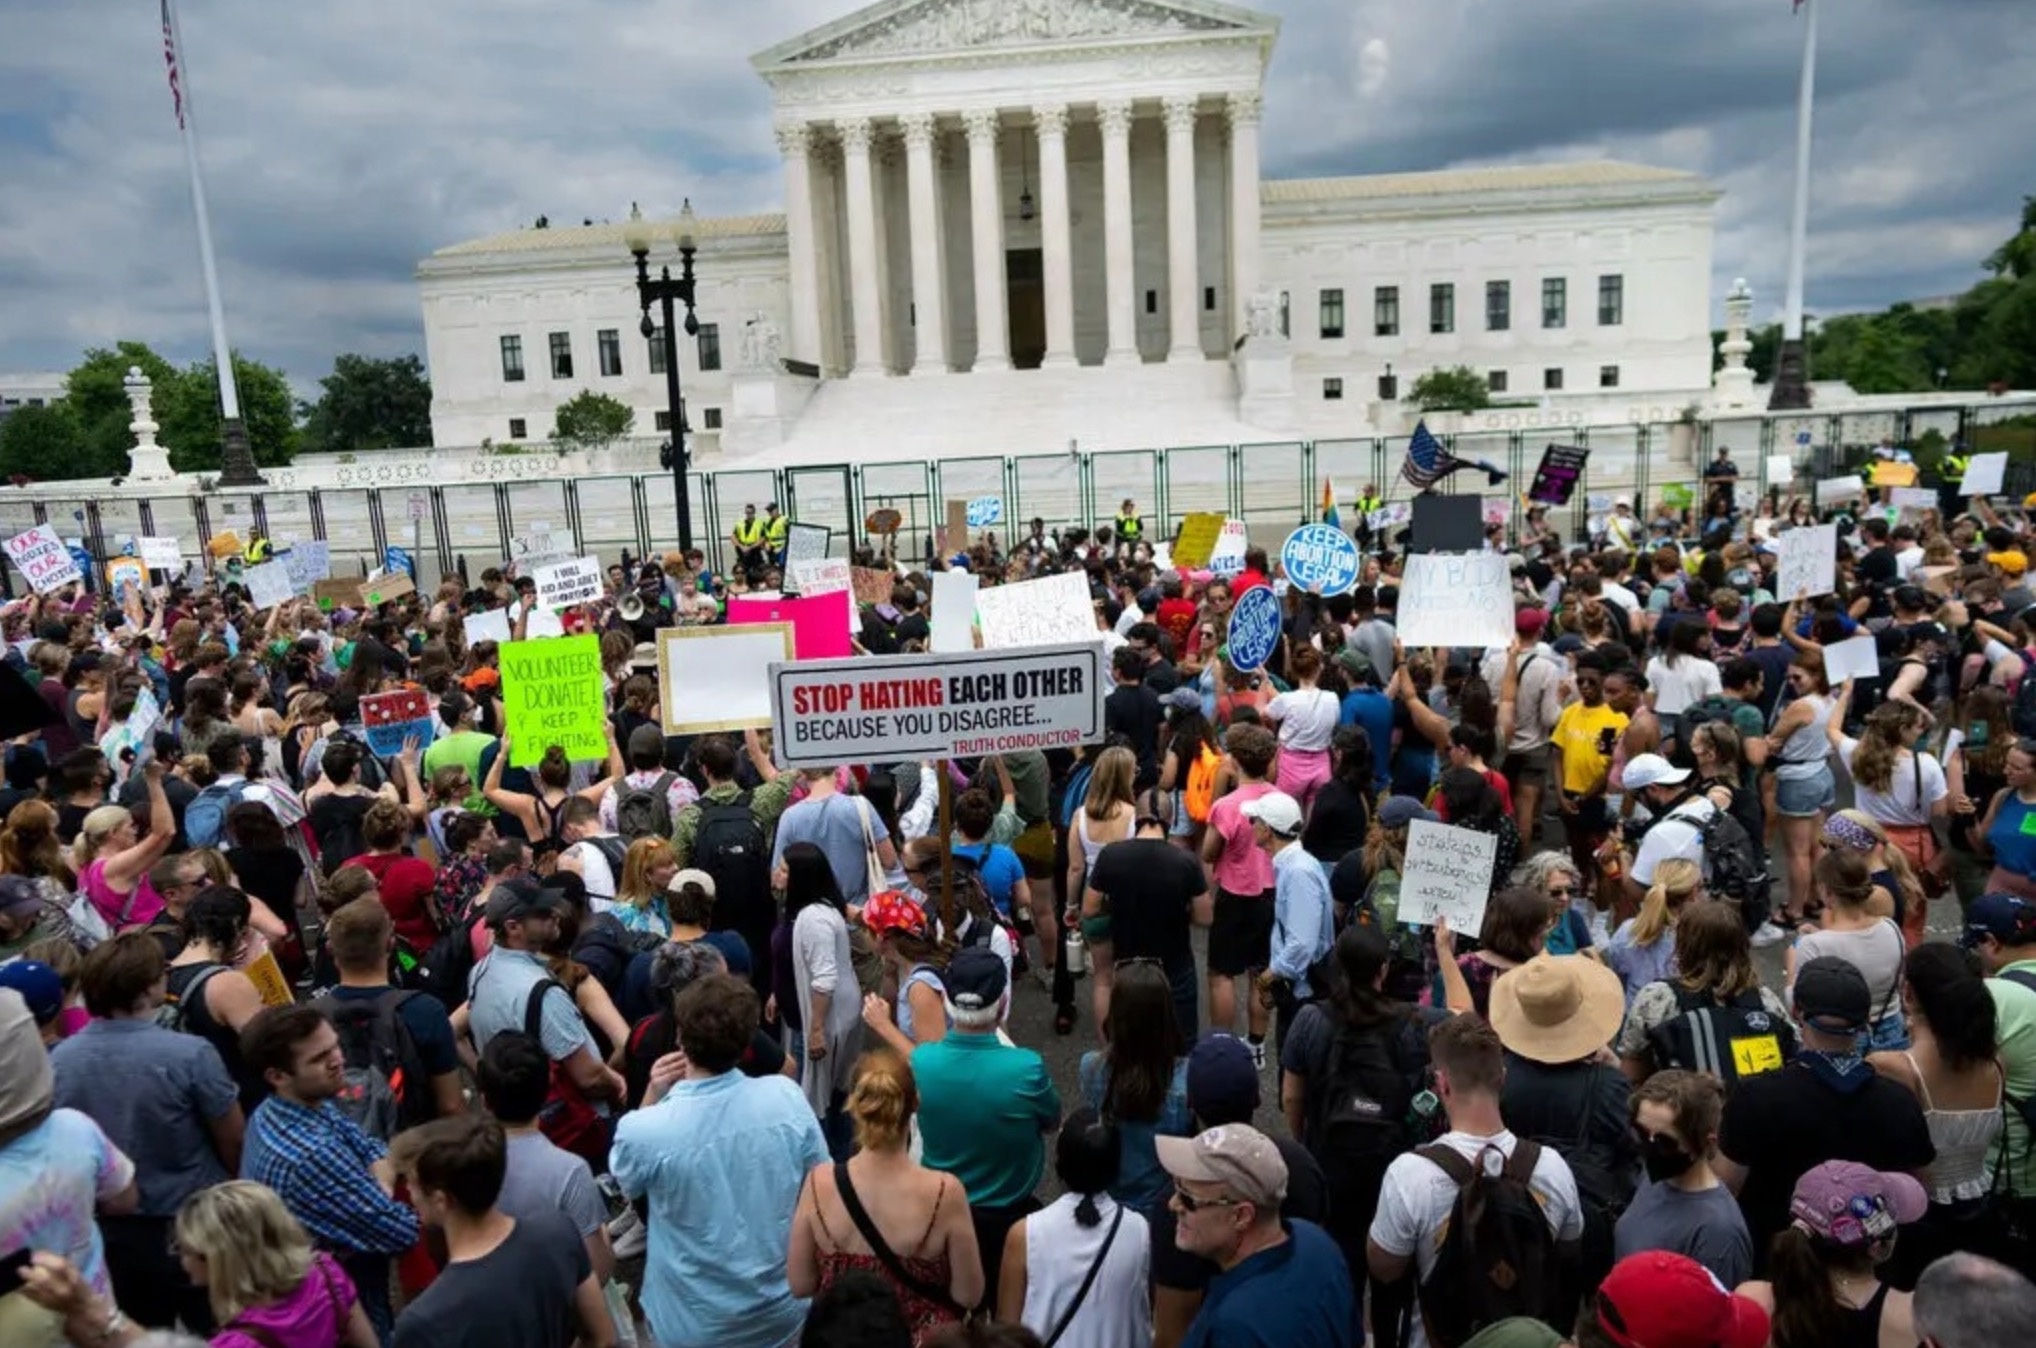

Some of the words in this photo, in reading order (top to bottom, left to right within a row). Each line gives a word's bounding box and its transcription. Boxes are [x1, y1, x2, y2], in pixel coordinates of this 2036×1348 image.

[10, 529, 48, 554] OUR
[1302, 528, 1347, 548] KEEP
[29, 553, 65, 578] OUR
[1287, 540, 1354, 572] ABORTION
[554, 570, 559, 579] I
[559, 566, 581, 577] WILL
[556, 580, 576, 590] AND
[1290, 560, 1346, 587] LEGAL
[1234, 589, 1263, 625] KEEP
[1232, 596, 1277, 655] ABORTION
[1240, 622, 1276, 664] LEGAL
[507, 652, 599, 681] VOLUNTEER
[524, 678, 597, 710] DONATE!
[793, 683, 854, 715] STOP
[859, 677, 943, 711] HATING
[949, 673, 1007, 704] EACH
[1013, 666, 1083, 699] OTHER
[541, 711, 578, 729] KEEP
[796, 716, 888, 742] BECAUSE
[893, 714, 932, 734] YOU
[939, 704, 1052, 733] DISAGREE...
[952, 738, 994, 754] TRUTH
[997, 730, 1080, 750] CONDUCTOR
